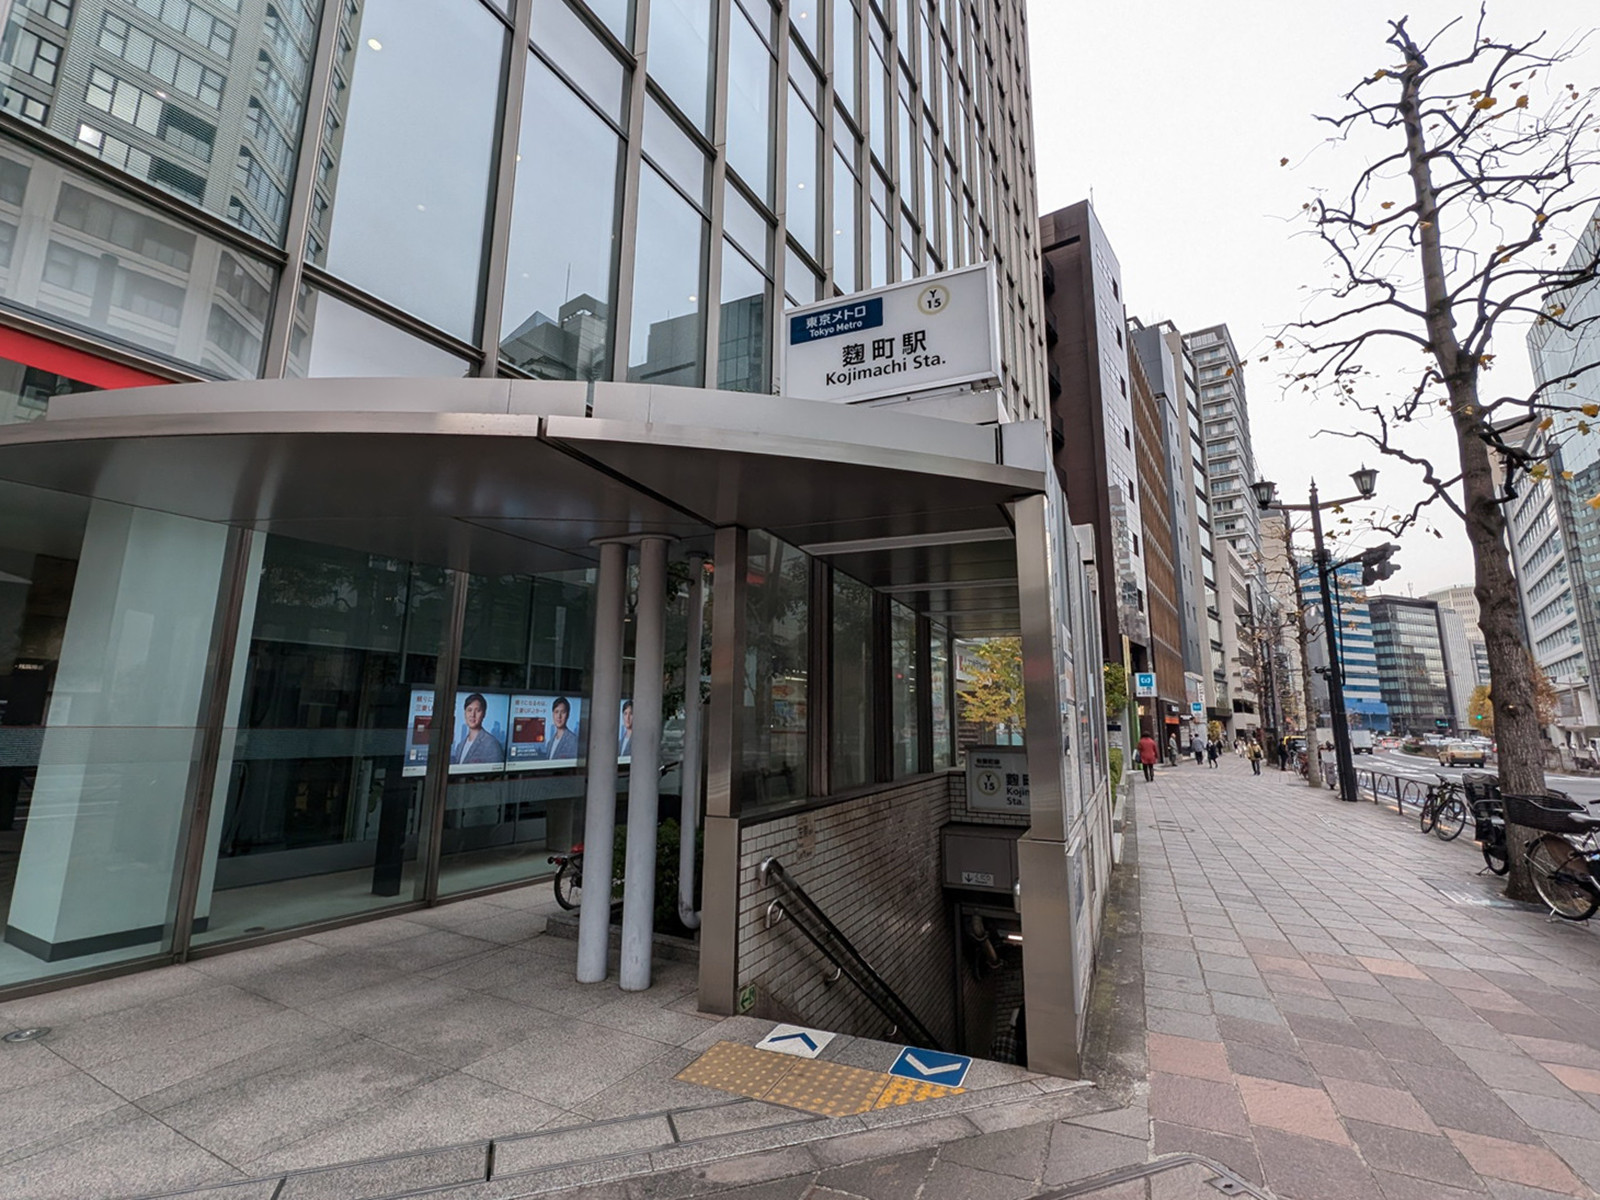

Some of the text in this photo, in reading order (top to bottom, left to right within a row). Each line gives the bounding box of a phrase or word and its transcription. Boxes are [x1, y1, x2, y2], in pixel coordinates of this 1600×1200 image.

[929, 289, 937, 298] Y
[927, 298, 941, 309] 15
[806, 305, 866, 329] 東京メトロ
[809, 320, 863, 338] Tokyo Metro
[826, 354, 946, 386] Kojimachi Sta.
[984, 782, 995, 790] 15
[1007, 797, 1024, 805] Sta.
